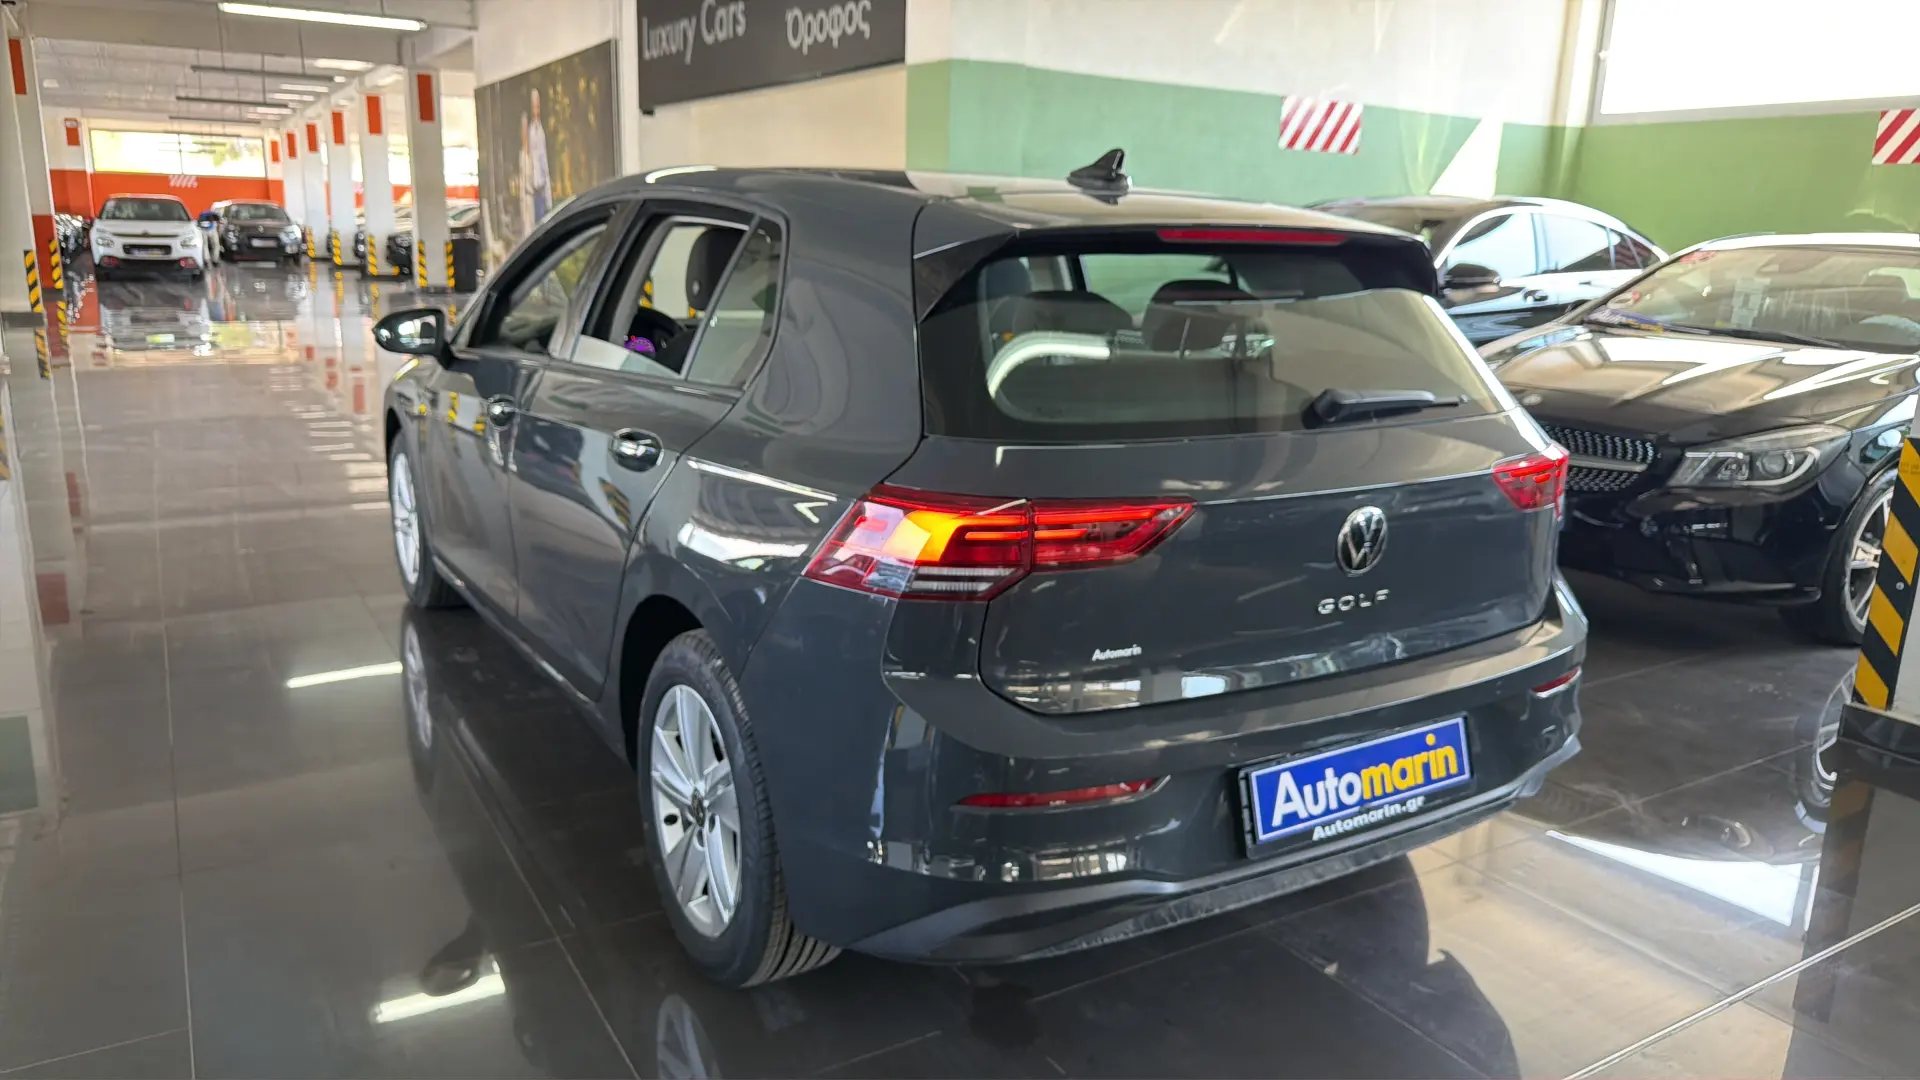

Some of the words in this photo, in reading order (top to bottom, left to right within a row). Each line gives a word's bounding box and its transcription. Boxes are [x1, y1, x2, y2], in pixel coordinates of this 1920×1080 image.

[642, 15, 697, 65] Luxury
[700, 0, 747, 45] Cars
[1317, 588, 1390, 615] GOLF
[1091, 643, 1142, 662] Automarin
[1271, 733, 1458, 827] Automarin
[1312, 795, 1426, 841] Automarin.gr
